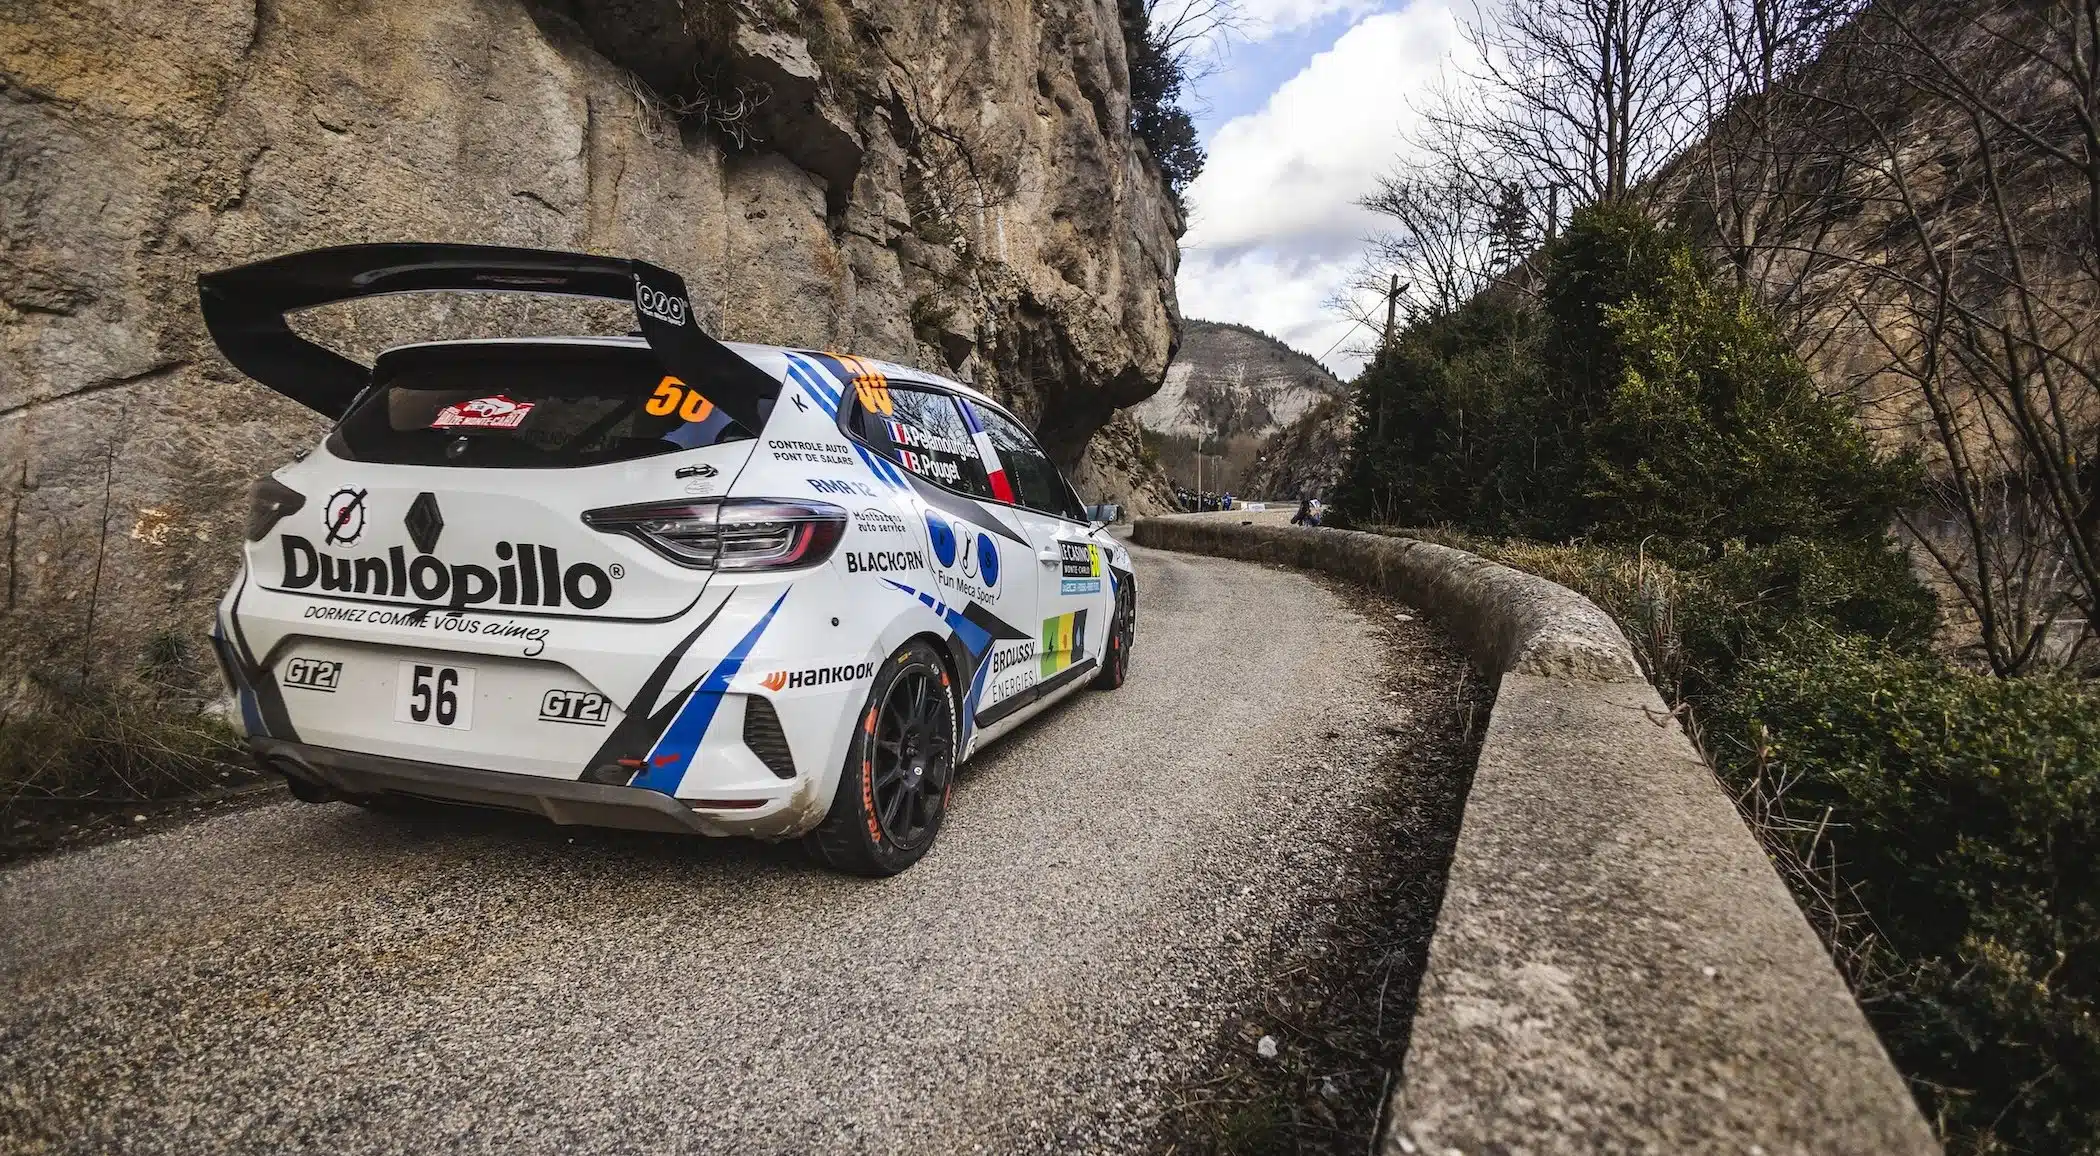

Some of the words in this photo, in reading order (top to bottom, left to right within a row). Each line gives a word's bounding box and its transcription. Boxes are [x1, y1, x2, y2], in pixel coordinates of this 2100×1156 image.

[790, 393, 809, 413] K
[768, 440, 824, 452] CONTROLE
[825, 444, 848, 454] AUTO
[773, 452, 803, 462] PONT
[805, 453, 820, 463] DE
[820, 454, 854, 466] SALARS
[911, 452, 961, 484] B.Pouget
[806, 479, 857, 495] RMA
[851, 481, 878, 497] 12
[879, 523, 906, 533] service
[846, 550, 924, 573] BLACKORN
[938, 570, 955, 589] Fun
[956, 577, 975, 597] Meca
[977, 587, 995, 605] Sport
[304, 605, 366, 622] DORMEZ
[367, 609, 430, 629] COMME
[435, 616, 480, 634] VOUS
[482, 620, 550, 657] aimez
[993, 641, 1035, 673] BROUSSY
[410, 664, 459, 726] 56
